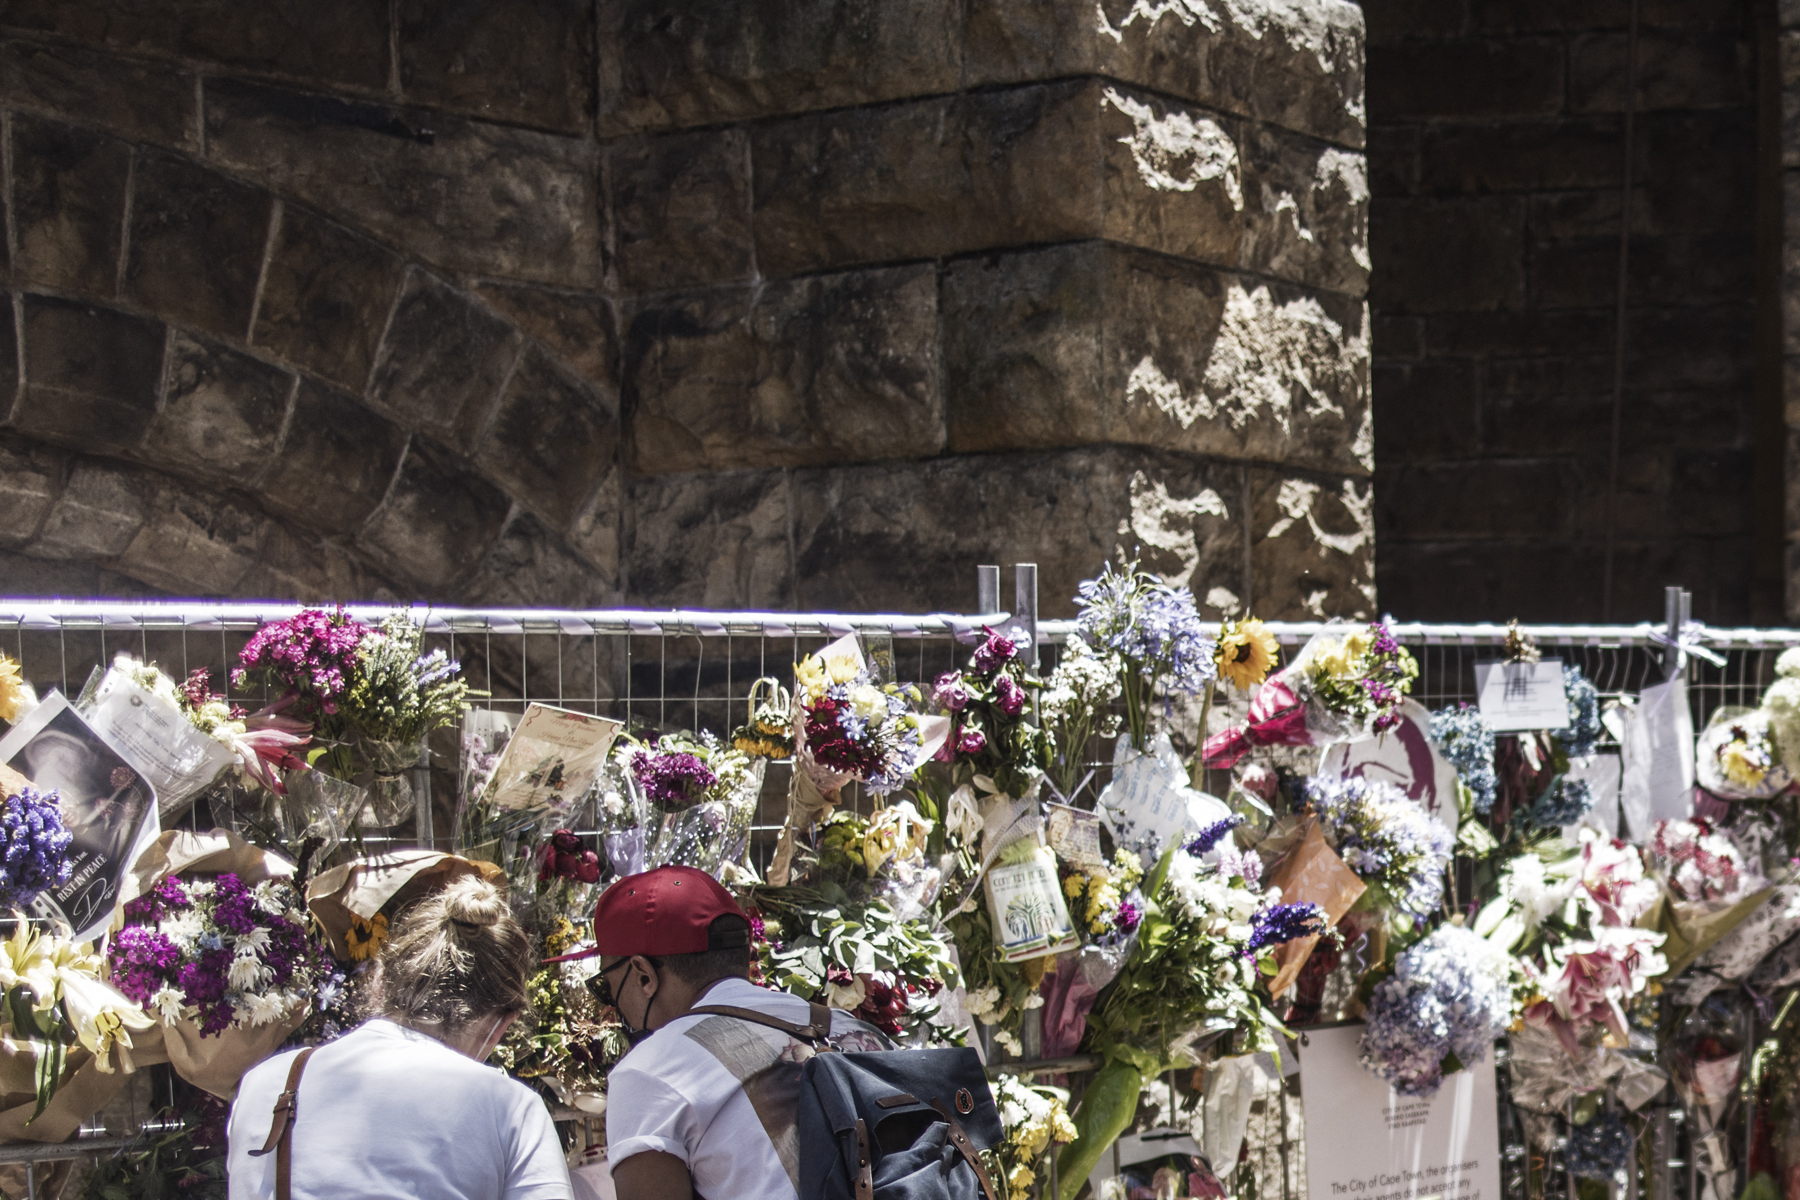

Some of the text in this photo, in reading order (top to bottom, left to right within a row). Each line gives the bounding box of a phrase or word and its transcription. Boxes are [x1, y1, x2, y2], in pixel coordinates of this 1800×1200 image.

[56, 883, 76, 902] REST
[74, 873, 86, 886] IN
[82, 853, 108, 878] PEACE
[1332, 1182, 1346, 1194] The
[1350, 1180, 1366, 1192] City
[1368, 1176, 1378, 1188] of
[1402, 1170, 1424, 1182] Town,
[1426, 1166, 1438, 1178] the
[1440, 1160, 1479, 1176] organisers
[1404, 1188, 1414, 1198] do
[1416, 1185, 1428, 1196] not
[1430, 1180, 1455, 1194] accept
[1458, 1178, 1471, 1189] any
[1472, 1190, 1480, 1200] of
